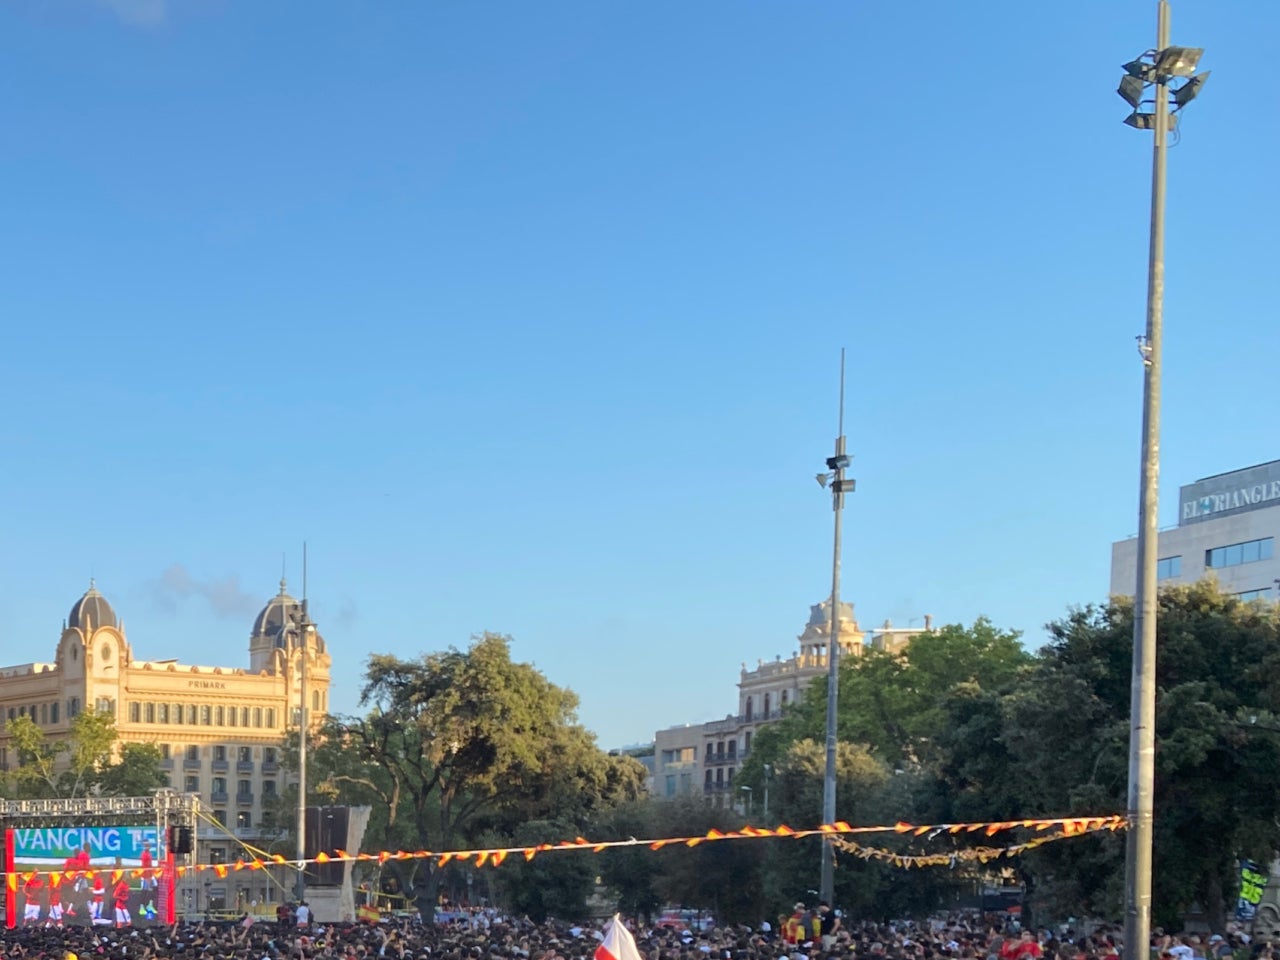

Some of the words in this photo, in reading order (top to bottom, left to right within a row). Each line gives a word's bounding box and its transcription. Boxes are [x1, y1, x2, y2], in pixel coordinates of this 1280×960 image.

[1183, 500, 1200, 519] EL
[1200, 480, 1280, 514] TRIANGLE
[188, 680, 226, 689] PRIMARK
[15, 828, 121, 851] VANCING
